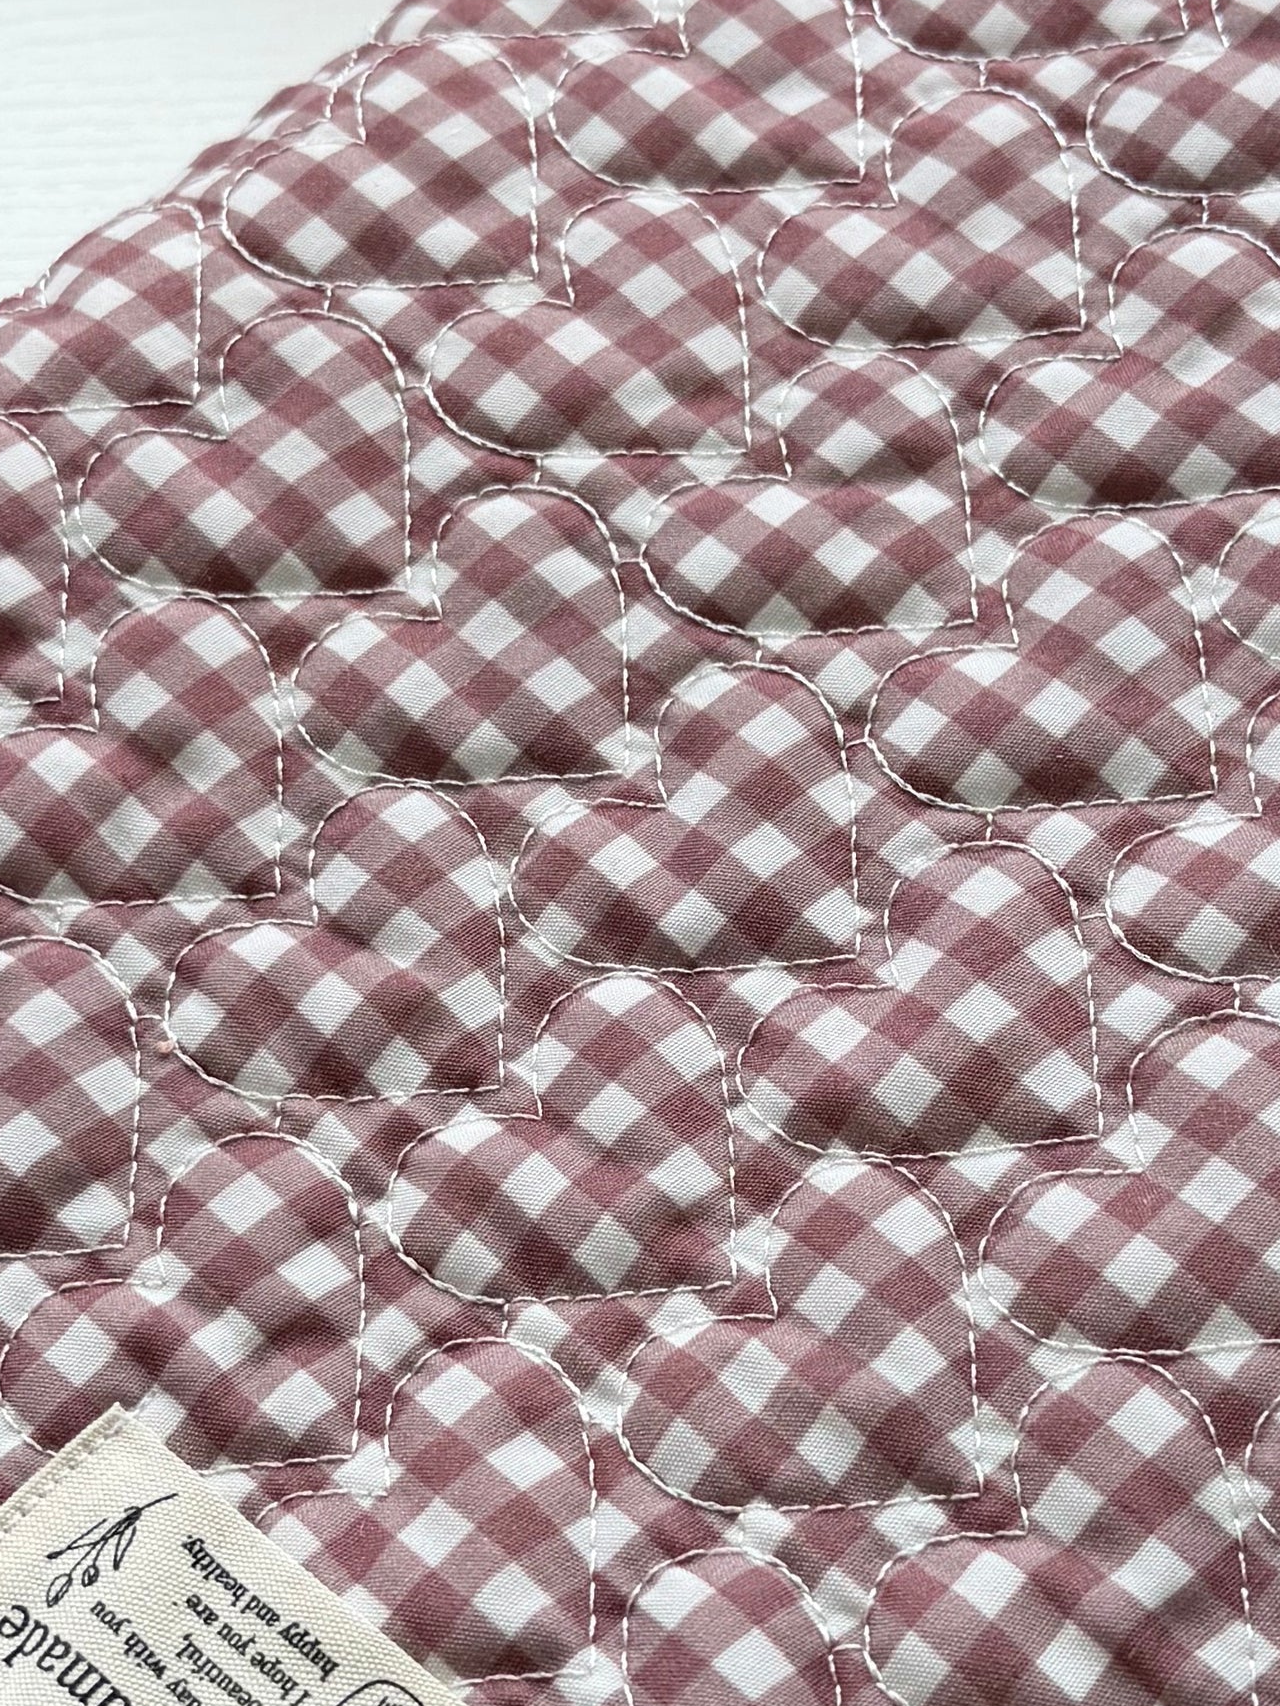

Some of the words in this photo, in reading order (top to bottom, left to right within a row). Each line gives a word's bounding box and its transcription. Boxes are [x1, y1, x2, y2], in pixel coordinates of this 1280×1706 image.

[181, 1534, 250, 1607] healthy.
[90, 1600, 132, 1637] you
[185, 1593, 220, 1626] are
[240, 1594, 281, 1627] and
[123, 1631, 170, 1681] with
[217, 1622, 258, 1657] you
[277, 1621, 341, 1683] happy
[250, 1650, 300, 1701] hope
